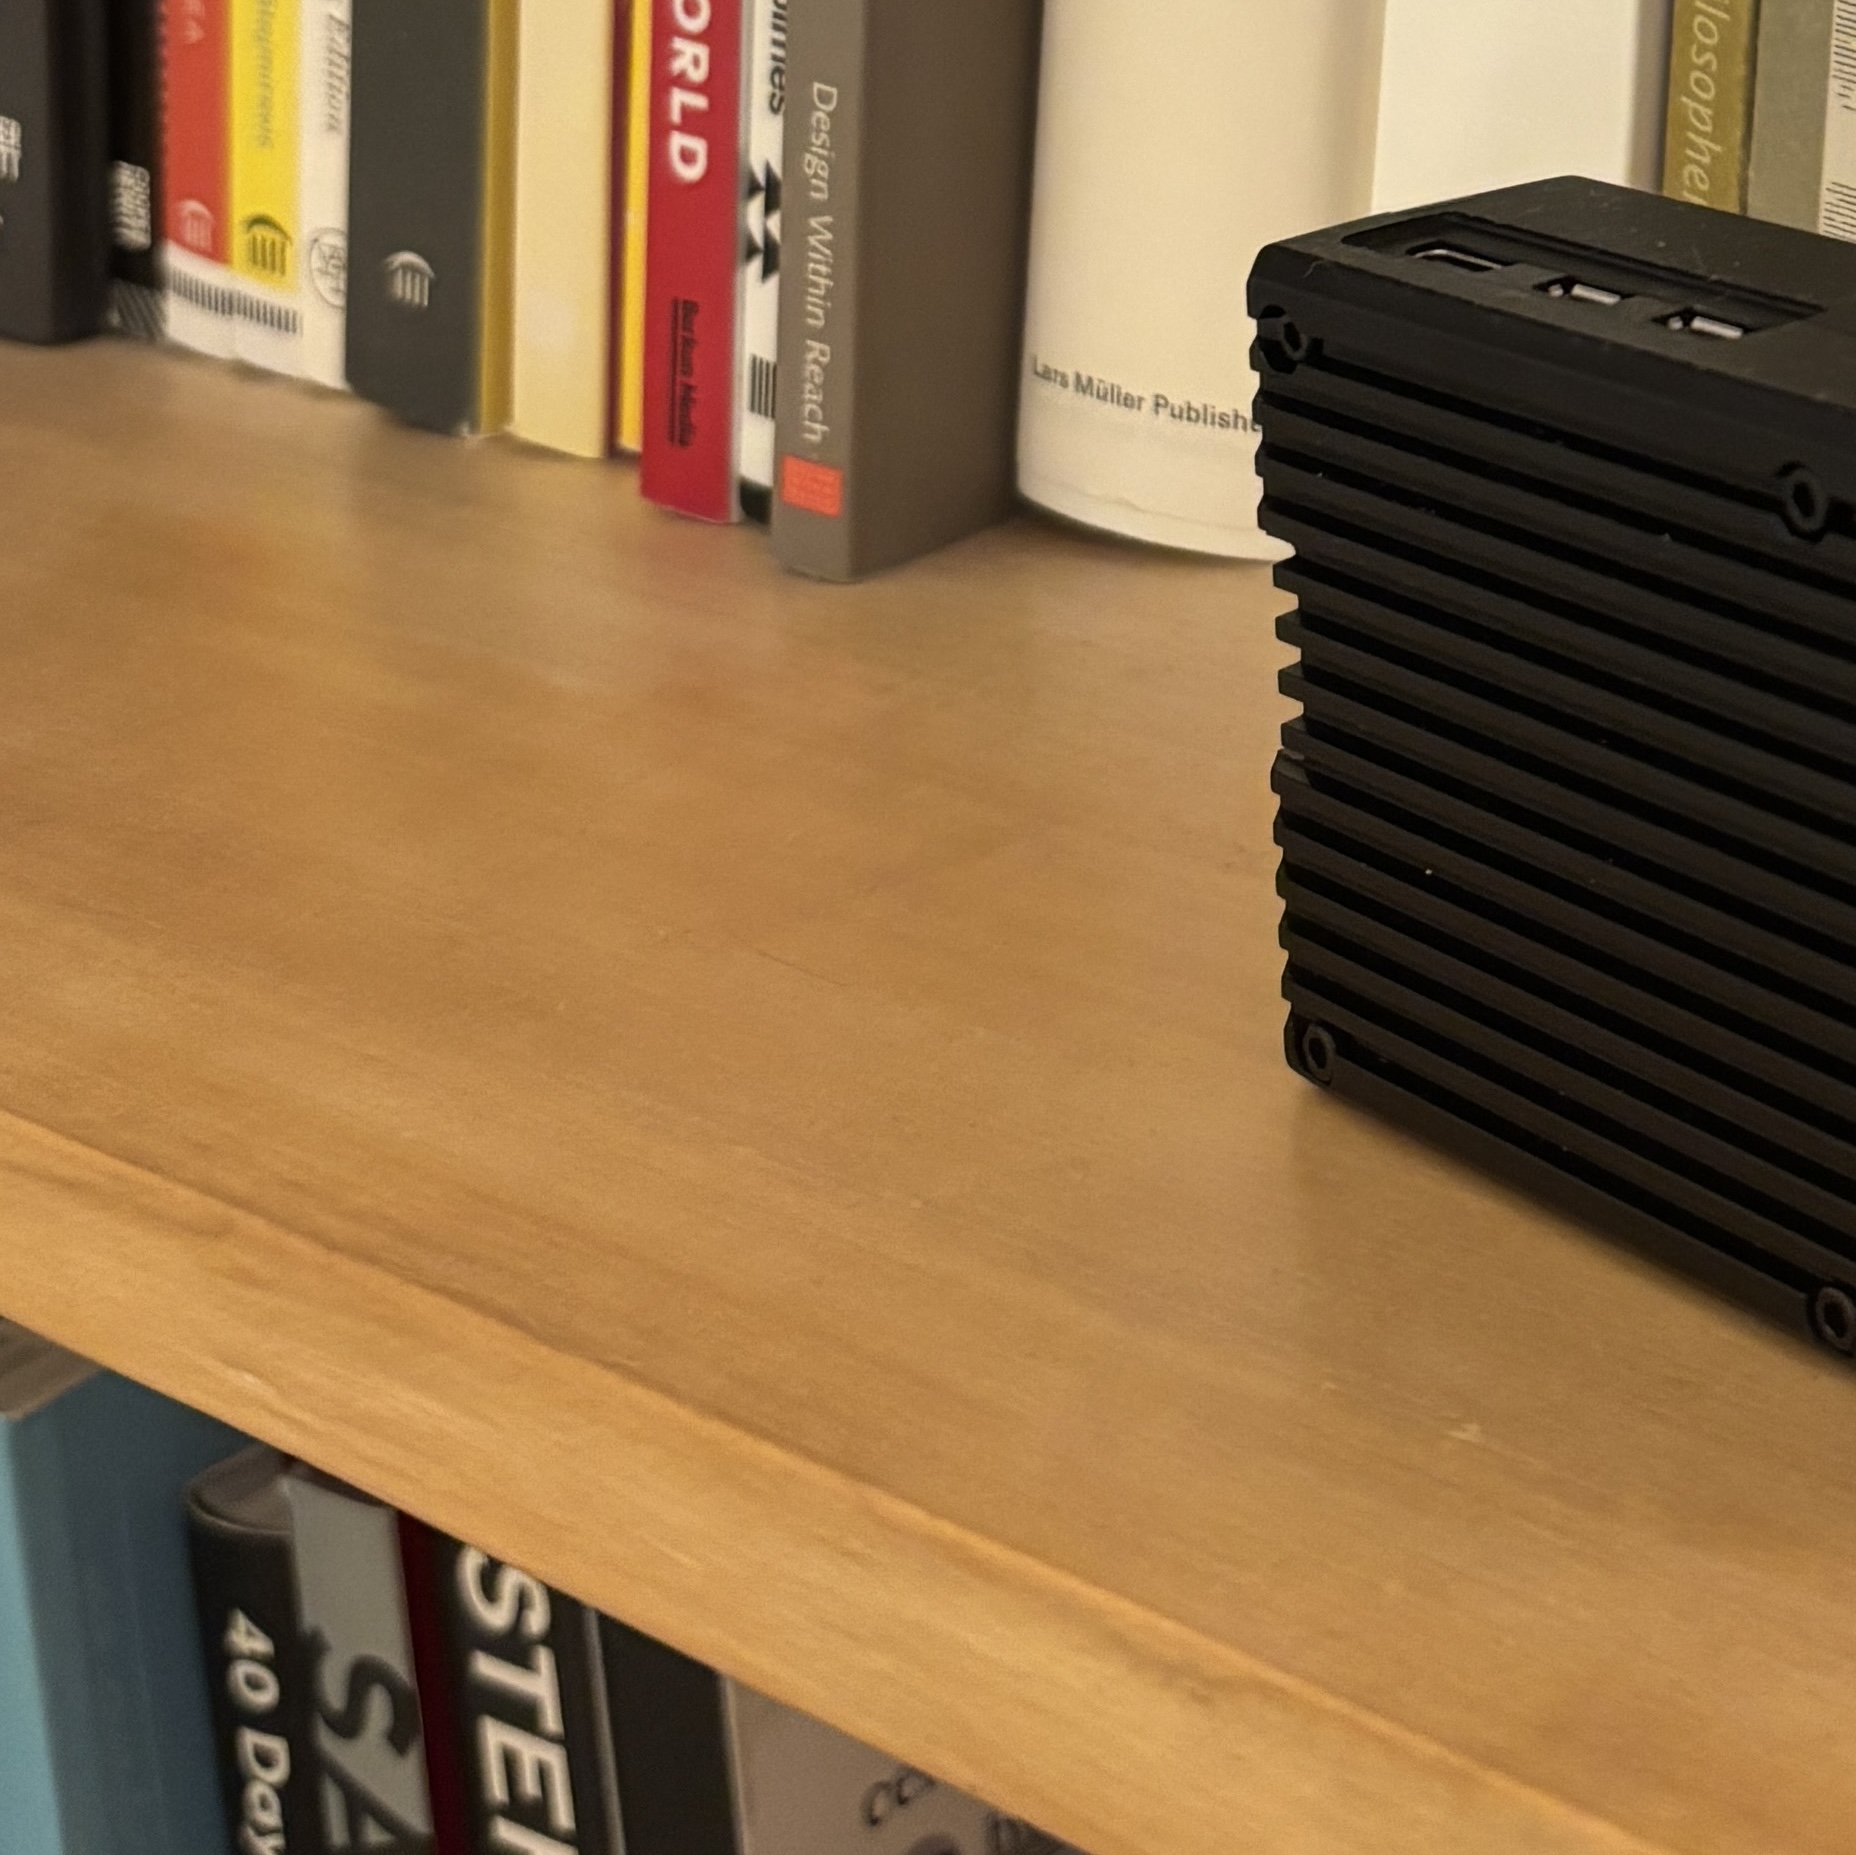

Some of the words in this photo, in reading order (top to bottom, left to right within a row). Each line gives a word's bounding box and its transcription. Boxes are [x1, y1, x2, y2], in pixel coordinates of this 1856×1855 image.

[803, 82, 839, 200] Design
[805, 215, 834, 327] Within
[801, 340, 832, 441] Reach
[1033, 354, 1069, 389] Lars
[1074, 372, 1144, 411] Müller
[223, 1608, 280, 1716] 40
